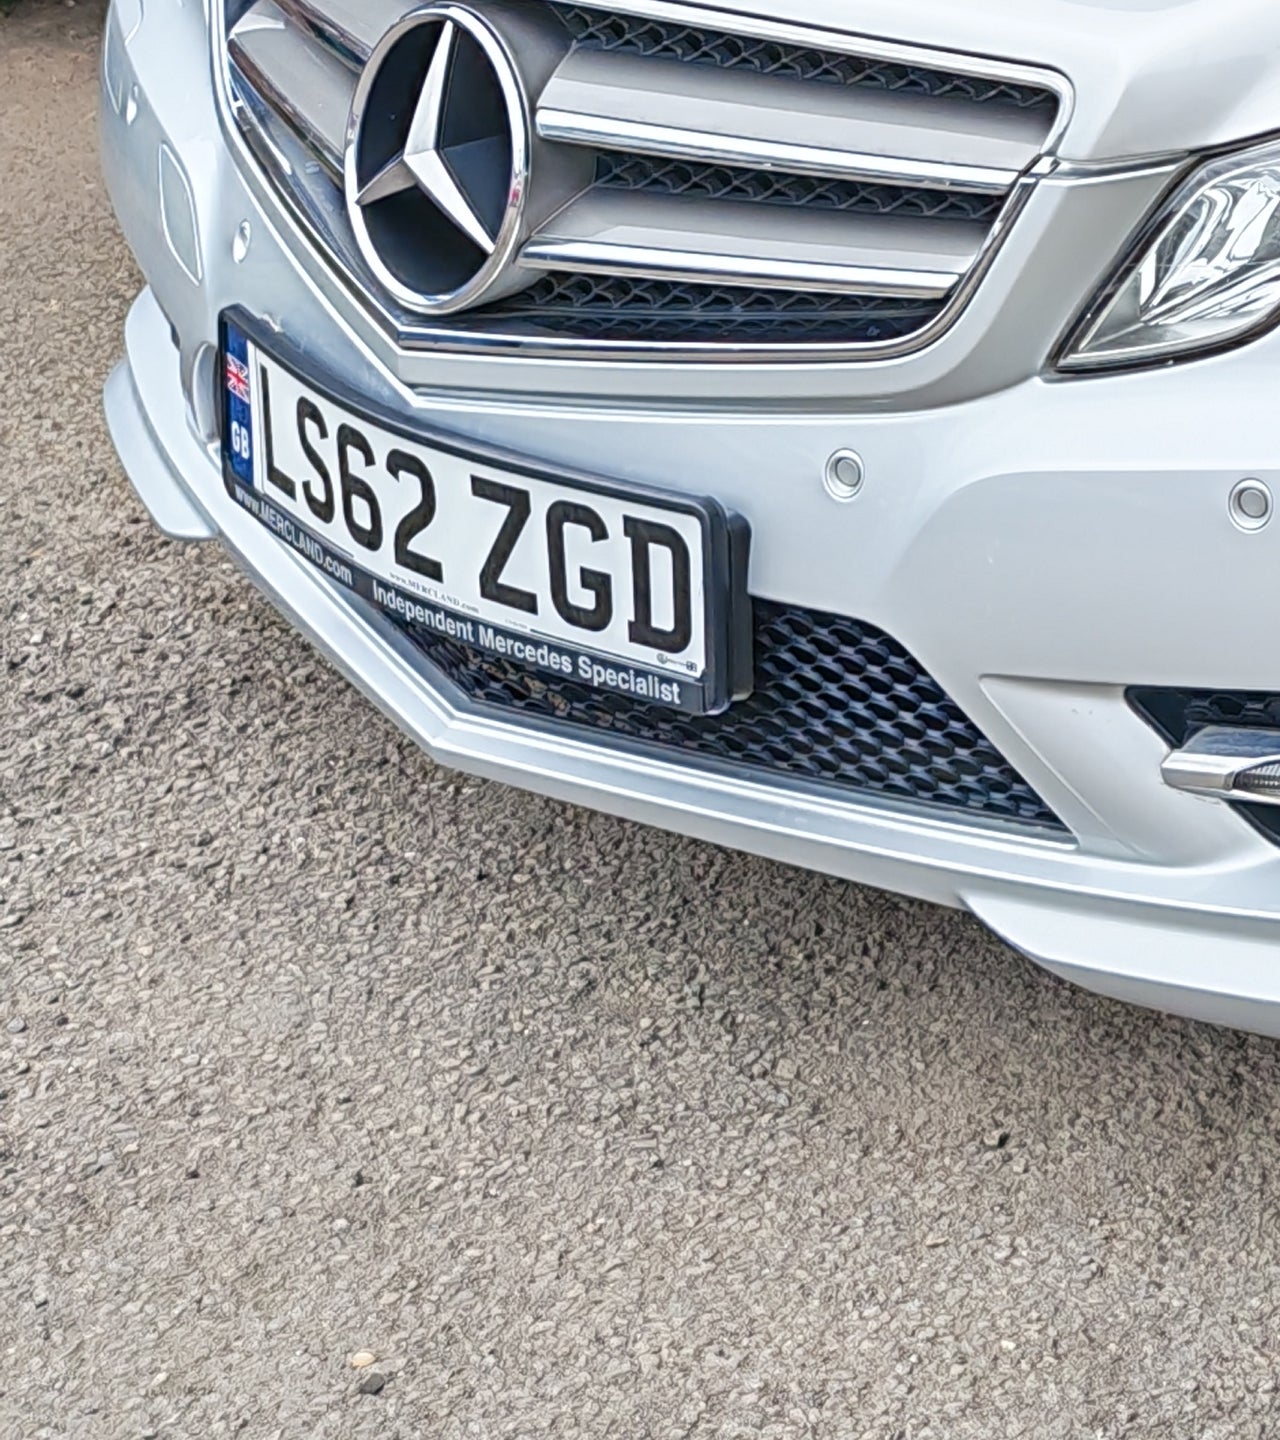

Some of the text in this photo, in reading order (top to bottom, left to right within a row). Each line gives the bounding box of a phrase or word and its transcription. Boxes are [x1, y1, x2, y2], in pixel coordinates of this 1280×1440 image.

[231, 421, 250, 459] GB
[260, 362, 692, 654] LS62 ZGD
[234, 483, 681, 705] www.MERCLAND.com Independent Mercedes Specialist
